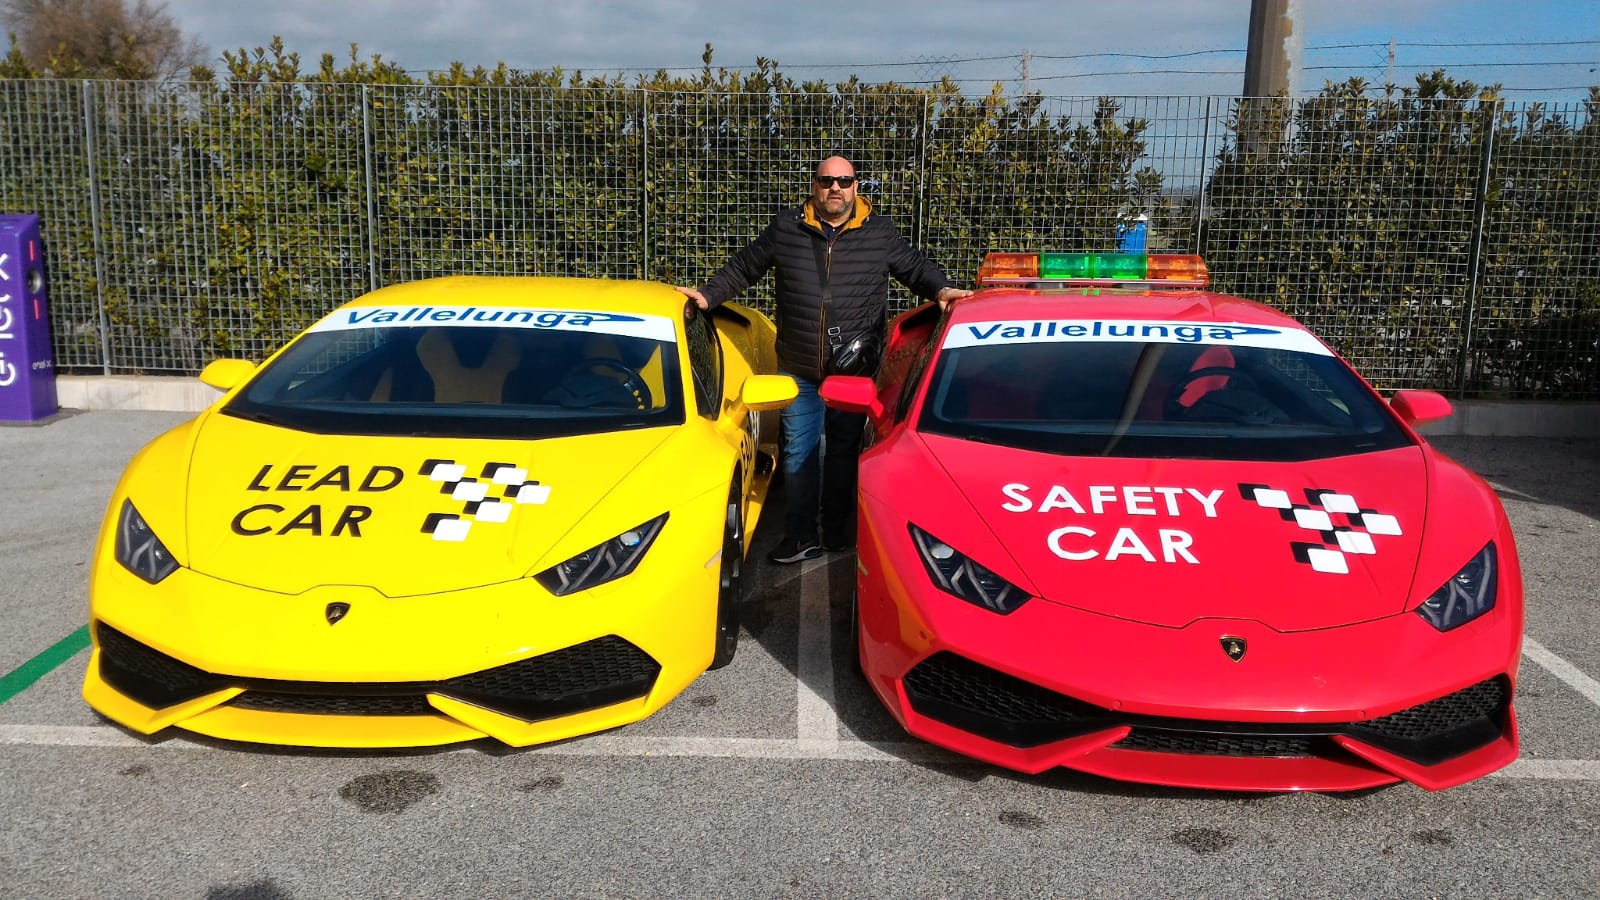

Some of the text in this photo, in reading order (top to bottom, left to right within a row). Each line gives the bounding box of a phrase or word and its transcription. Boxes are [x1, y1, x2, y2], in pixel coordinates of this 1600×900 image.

[348, 307, 594, 328] Vallelunga
[968, 321, 1234, 343] Vallelunga
[246, 464, 404, 492] LEAD
[1001, 483, 1224, 517] SAFETY
[231, 504, 372, 537] CAR
[1047, 526, 1200, 564] CAR
